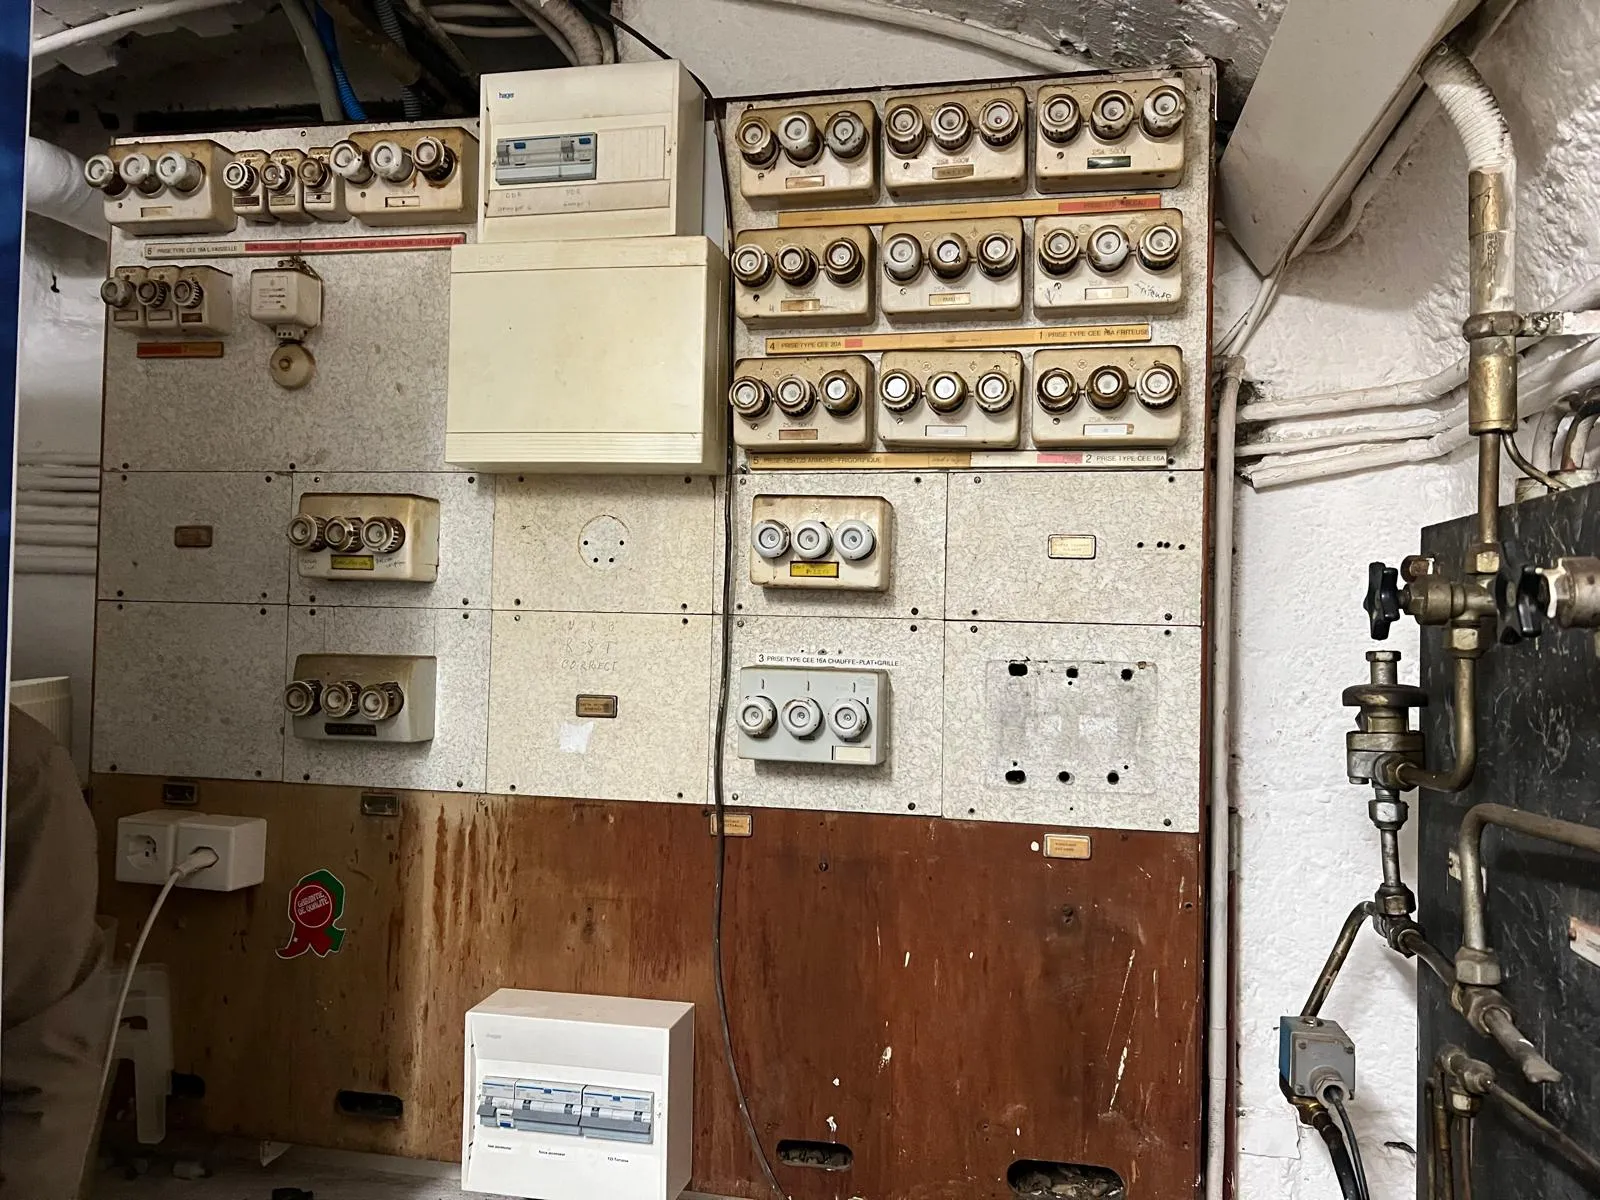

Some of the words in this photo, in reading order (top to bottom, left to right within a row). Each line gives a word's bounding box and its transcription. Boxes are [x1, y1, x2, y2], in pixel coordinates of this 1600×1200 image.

[1087, 329, 1101, 337] CEE
[1116, 328, 1148, 336] FRITEUSE
[769, 342, 775, 350] 4
[753, 456, 759, 465] 5
[1085, 454, 1092, 463] 2
[758, 654, 765, 663] 3
[561, 659, 618, 672] CORRECT
[297, 907, 306, 916] DE
